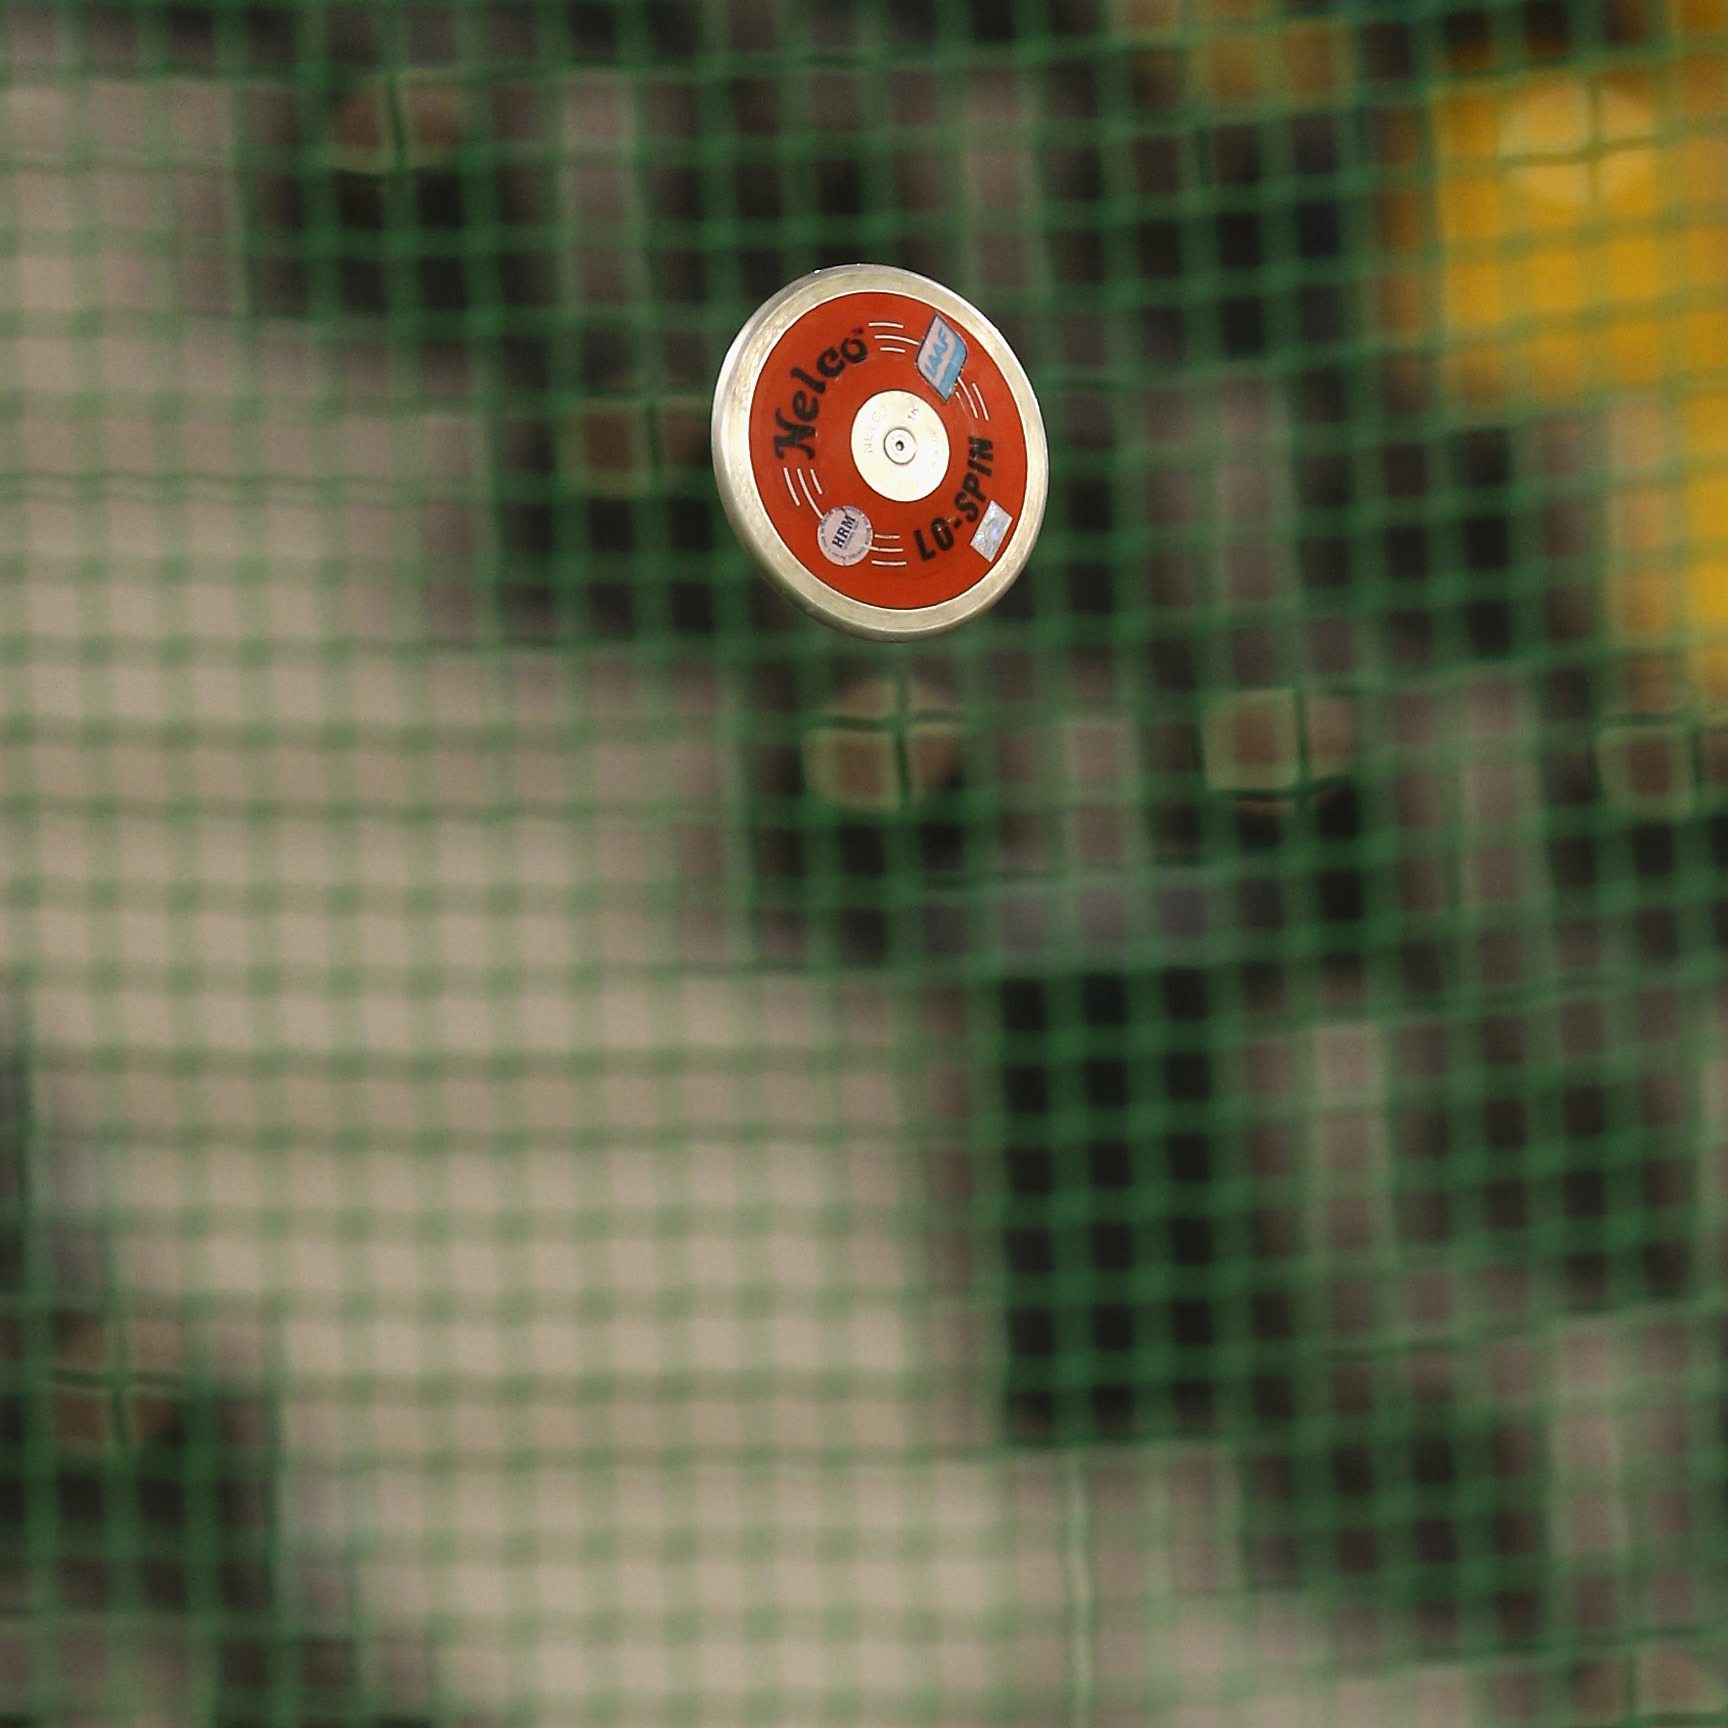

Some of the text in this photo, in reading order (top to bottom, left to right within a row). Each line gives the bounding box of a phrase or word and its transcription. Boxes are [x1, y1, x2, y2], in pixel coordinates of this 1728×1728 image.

[773, 334, 868, 461] Nelco
[832, 515, 857, 549] HRM
[913, 436, 994, 561] LO-SPIN
